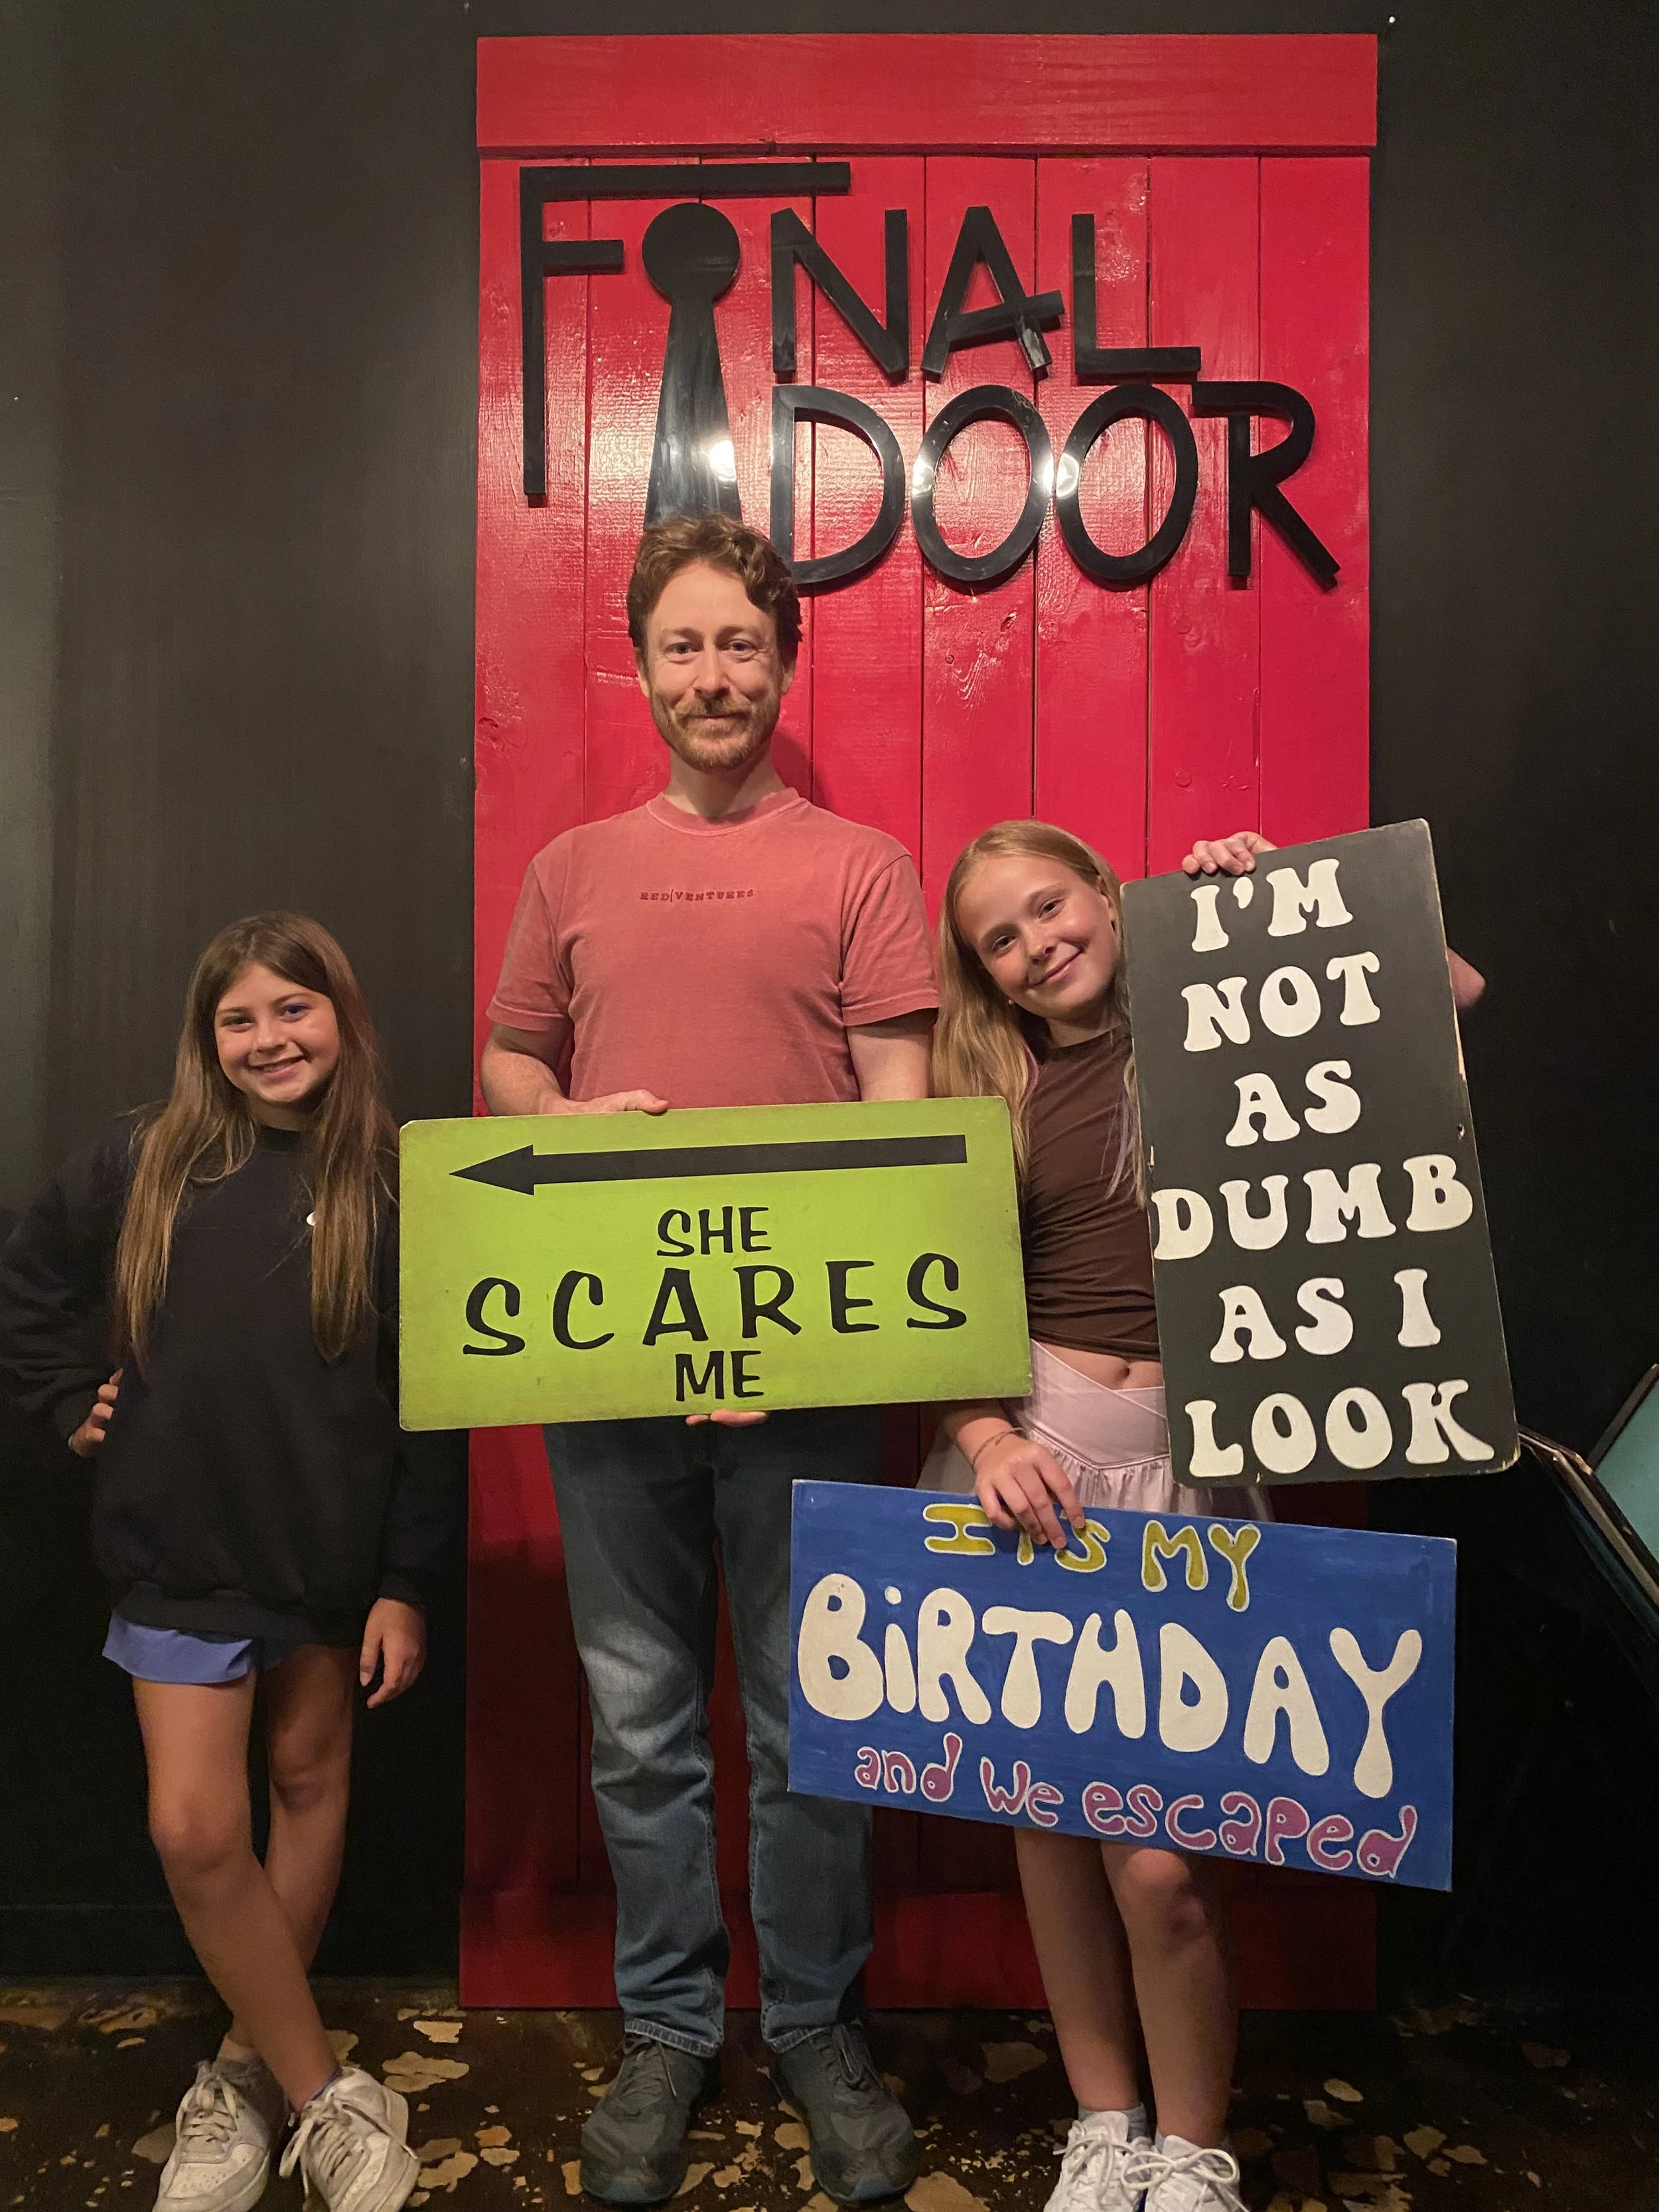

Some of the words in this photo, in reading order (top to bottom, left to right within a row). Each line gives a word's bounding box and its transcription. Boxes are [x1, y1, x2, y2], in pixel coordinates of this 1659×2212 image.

[770, 380, 1341, 595] DOOR
[1191, 858, 1354, 952] I'M
[1181, 951, 1381, 1051] NOT
[1225, 1060, 1361, 1147] AS
[657, 1206, 771, 1257] SHE
[1151, 1154, 1473, 1260] DUMB
[463, 1252, 968, 1356] SCARES
[1210, 1278, 1354, 1363] AS
[1394, 1268, 1441, 1347] I
[675, 1350, 764, 1402] ME
[1185, 1379, 1494, 1478] LOOK
[1141, 1520, 1262, 1612] MY
[854, 1732, 963, 1803] and
